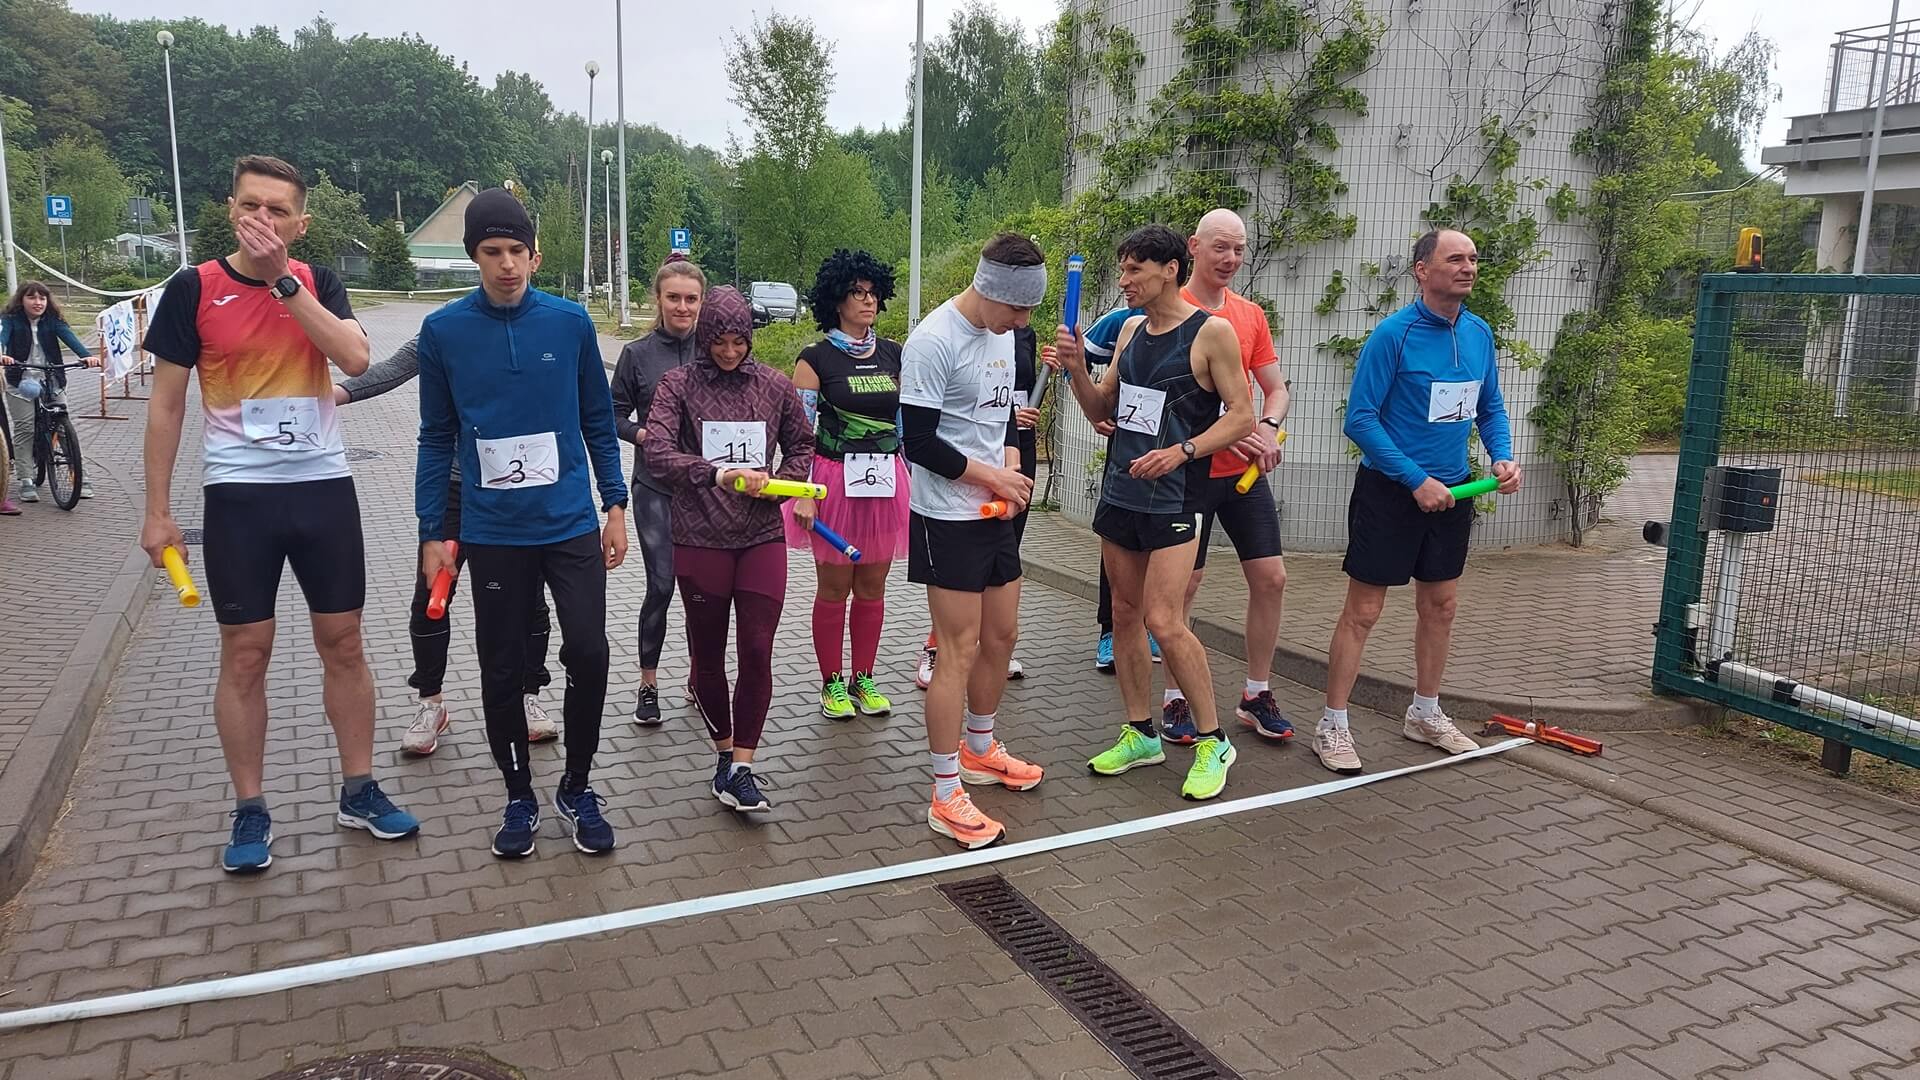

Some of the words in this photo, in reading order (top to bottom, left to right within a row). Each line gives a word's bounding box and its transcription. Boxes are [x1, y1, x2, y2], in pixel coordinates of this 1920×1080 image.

[51, 198, 66, 216] P
[674, 230, 686, 247] P
[847, 374, 892, 384] OUTDOOR
[991, 385, 1010, 408] 10
[1125, 403, 1138, 425] 7
[1455, 399, 1464, 421] 1
[278, 421, 296, 446] 5
[292, 416, 299, 426] 1
[723, 441, 751, 464] 11
[747, 438, 753, 446] 1
[508, 459, 526, 484] 3
[522, 454, 529, 463] 1
[865, 467, 877, 486] 6
